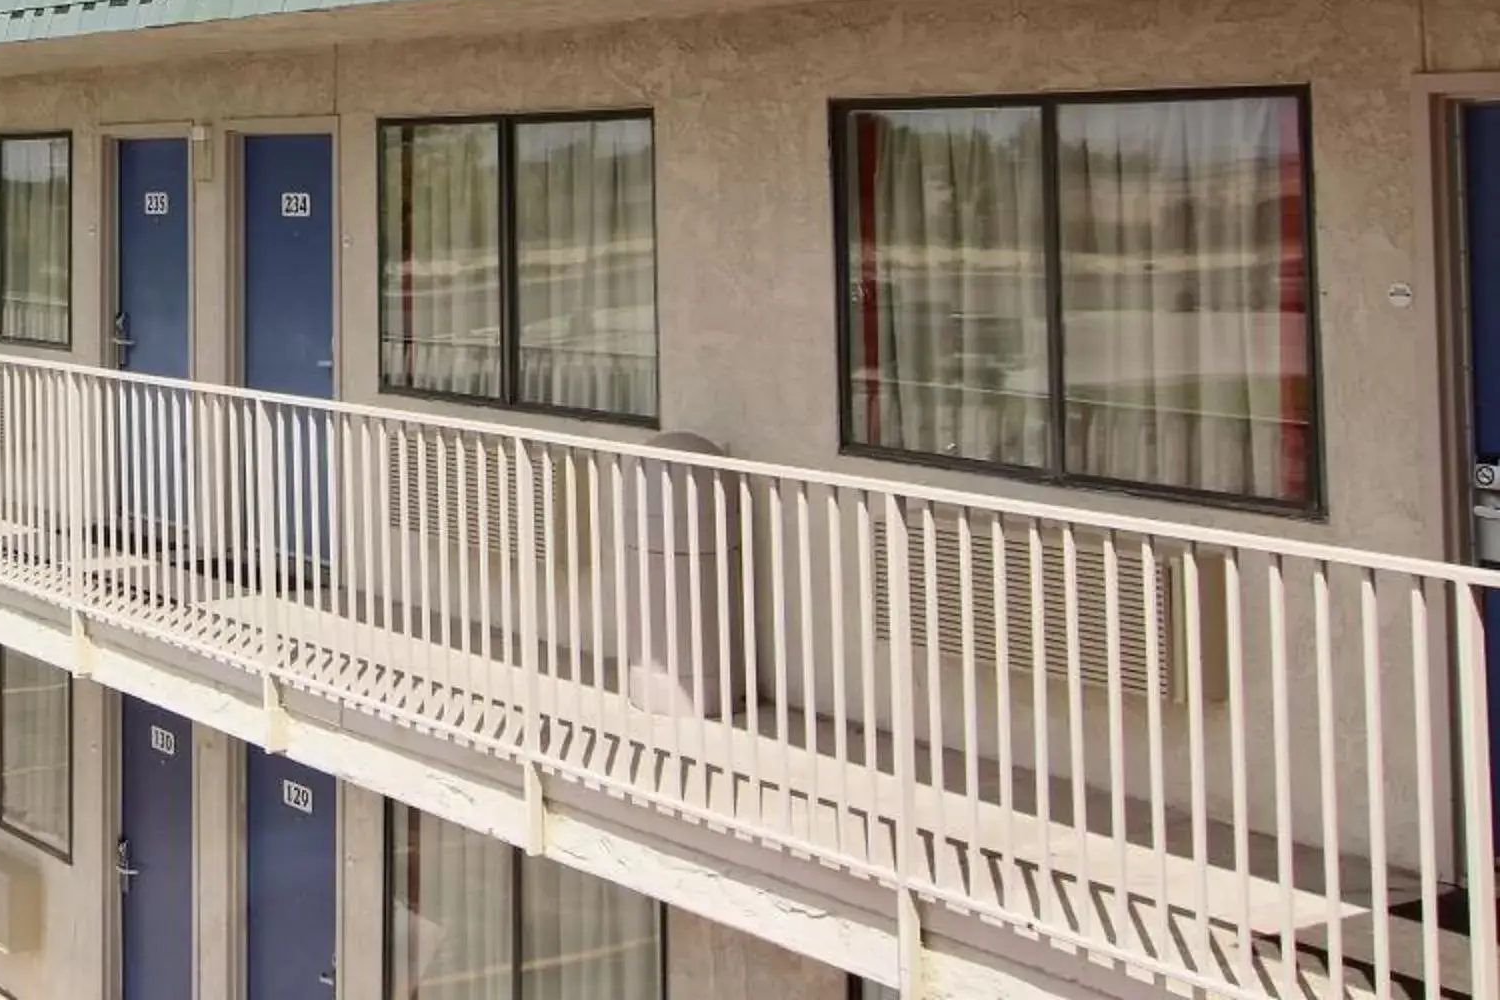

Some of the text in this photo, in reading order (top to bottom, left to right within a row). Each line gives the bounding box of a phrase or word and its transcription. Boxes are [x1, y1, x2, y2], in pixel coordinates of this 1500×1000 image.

[147, 195, 166, 211] 235
[284, 195, 308, 214] 234
[154, 728, 174, 751] 130
[286, 783, 310, 808] 129
